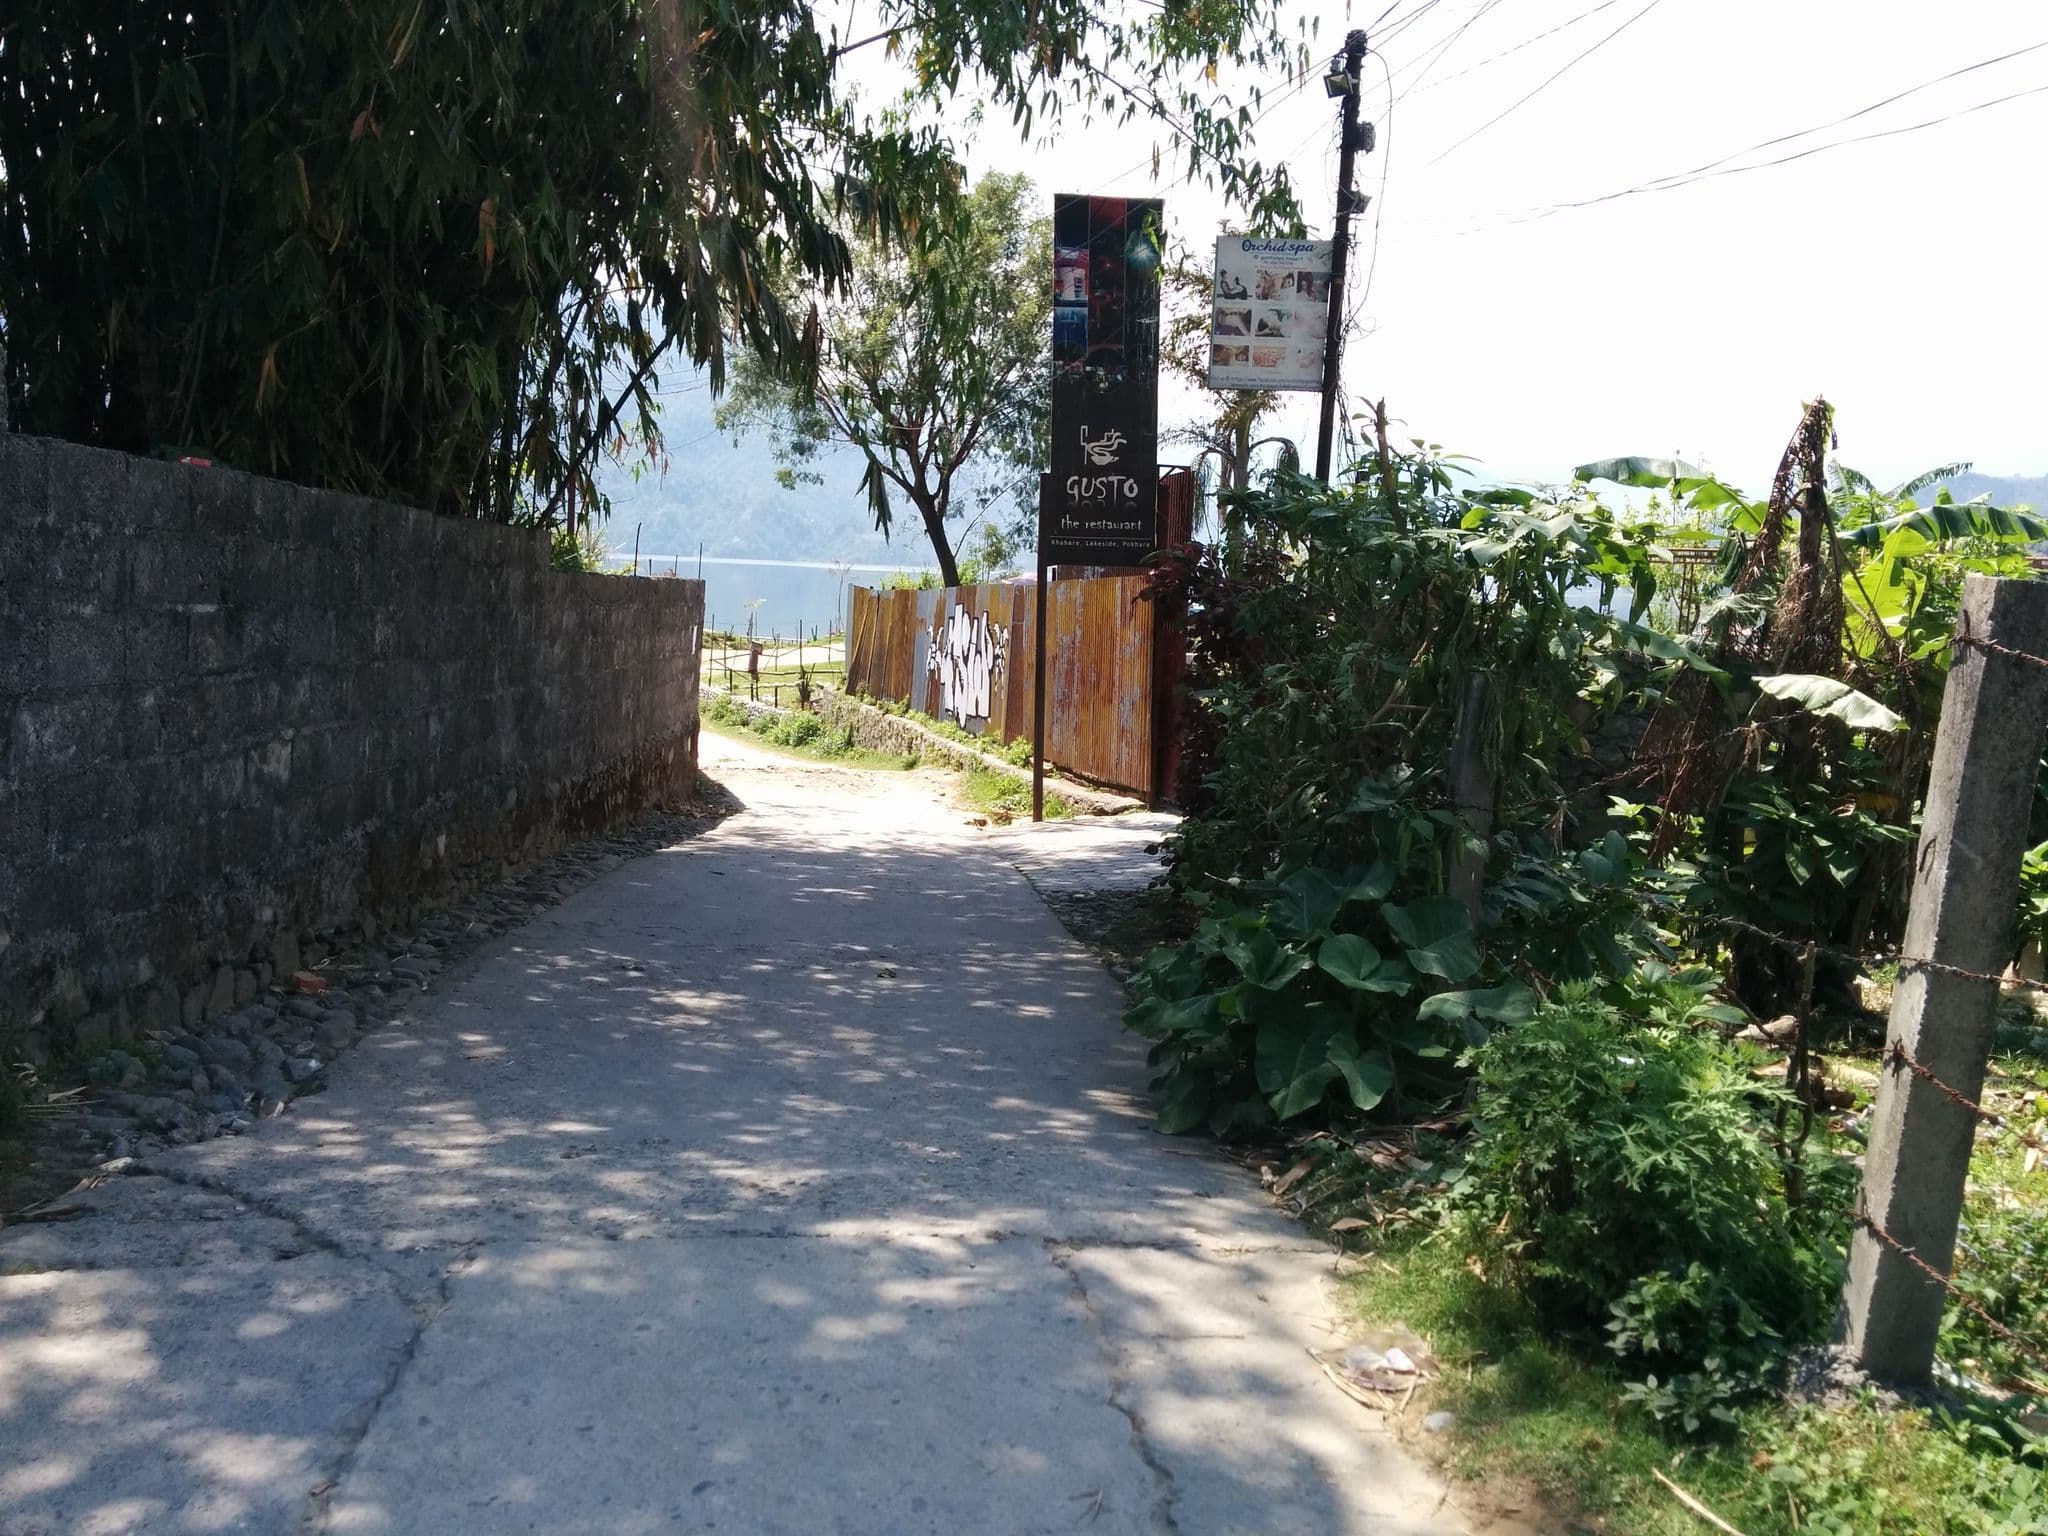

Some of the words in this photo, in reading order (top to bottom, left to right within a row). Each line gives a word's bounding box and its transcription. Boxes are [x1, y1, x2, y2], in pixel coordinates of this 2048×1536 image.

[1242, 239, 1287, 252] Orchid
[1288, 244, 1314, 256] spa
[1066, 475, 1139, 504] GUSTO
[1061, 514, 1080, 529] the
[1085, 519, 1142, 531] restaurant
